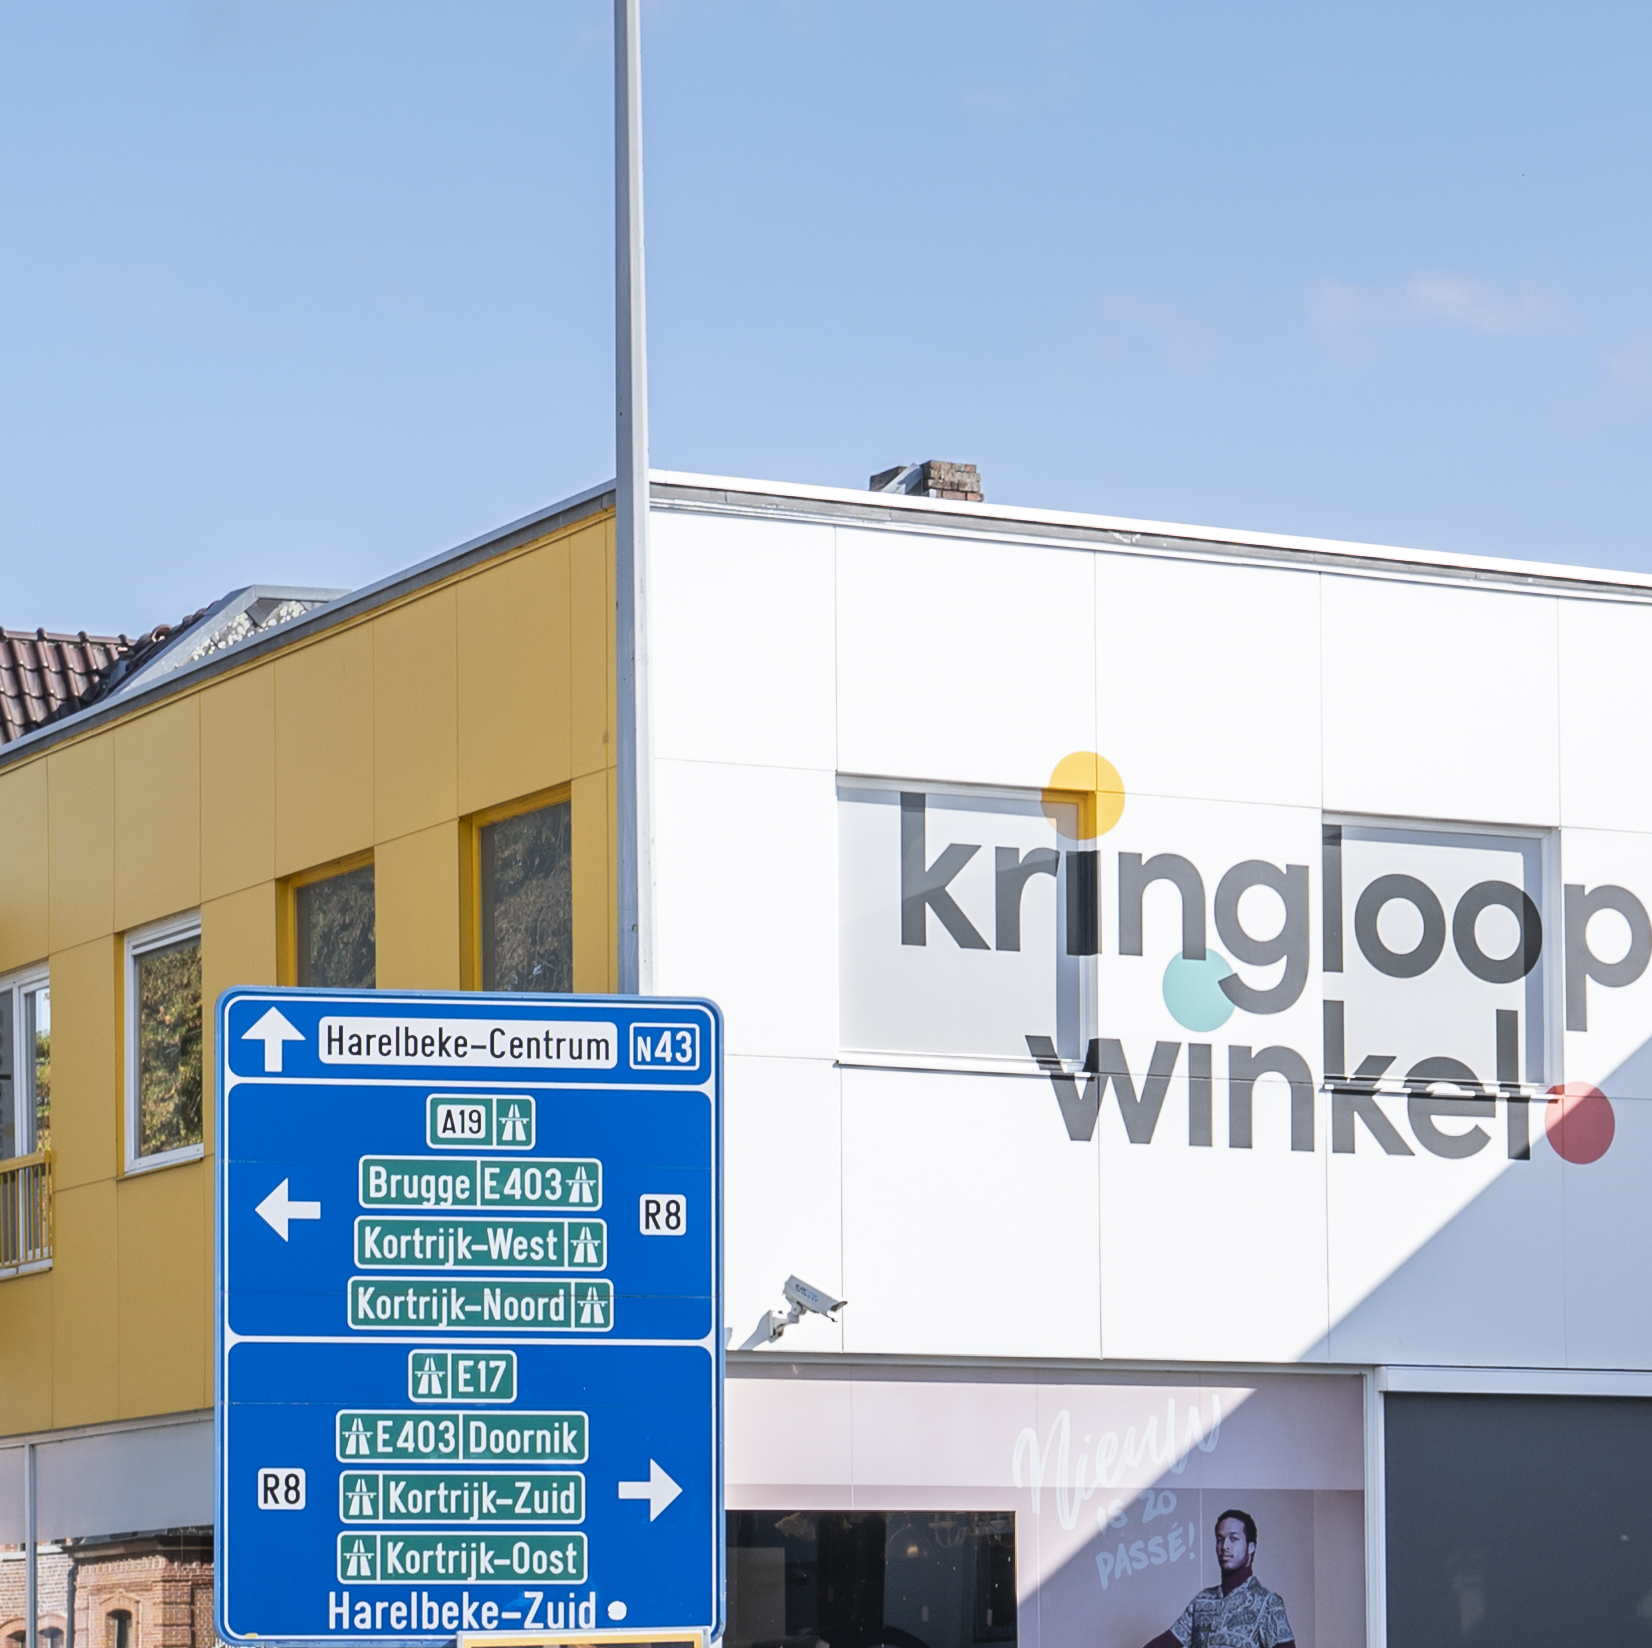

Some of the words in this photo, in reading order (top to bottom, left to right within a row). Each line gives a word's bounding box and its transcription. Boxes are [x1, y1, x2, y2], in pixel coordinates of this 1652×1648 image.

[900, 752, 1652, 1031] kringloop
[326, 1025, 610, 1061] Harelbeke-Centrum
[636, 1031, 693, 1064] N43
[442, 1109, 482, 1135] A19
[369, 1166, 469, 1206] Brugge
[484, 1167, 562, 1200] E403
[645, 1200, 682, 1230] R8
[364, 1227, 558, 1267] Kortrijk-West
[357, 1288, 565, 1327] Kortrijk-Noord
[457, 1360, 507, 1393] E17
[377, 1420, 455, 1453] E403
[469, 1421, 578, 1454] Doornik
[1012, 1394, 1221, 1529] Nieuw
[263, 1474, 301, 1504] R8
[388, 1481, 575, 1521] Kortrijk-Zuid
[387, 1542, 577, 1582] Kortrijk-Oost
[1095, 1522, 1196, 1588] PASSÉ!
[329, 1591, 596, 1630] Harelbeke-Zuid
